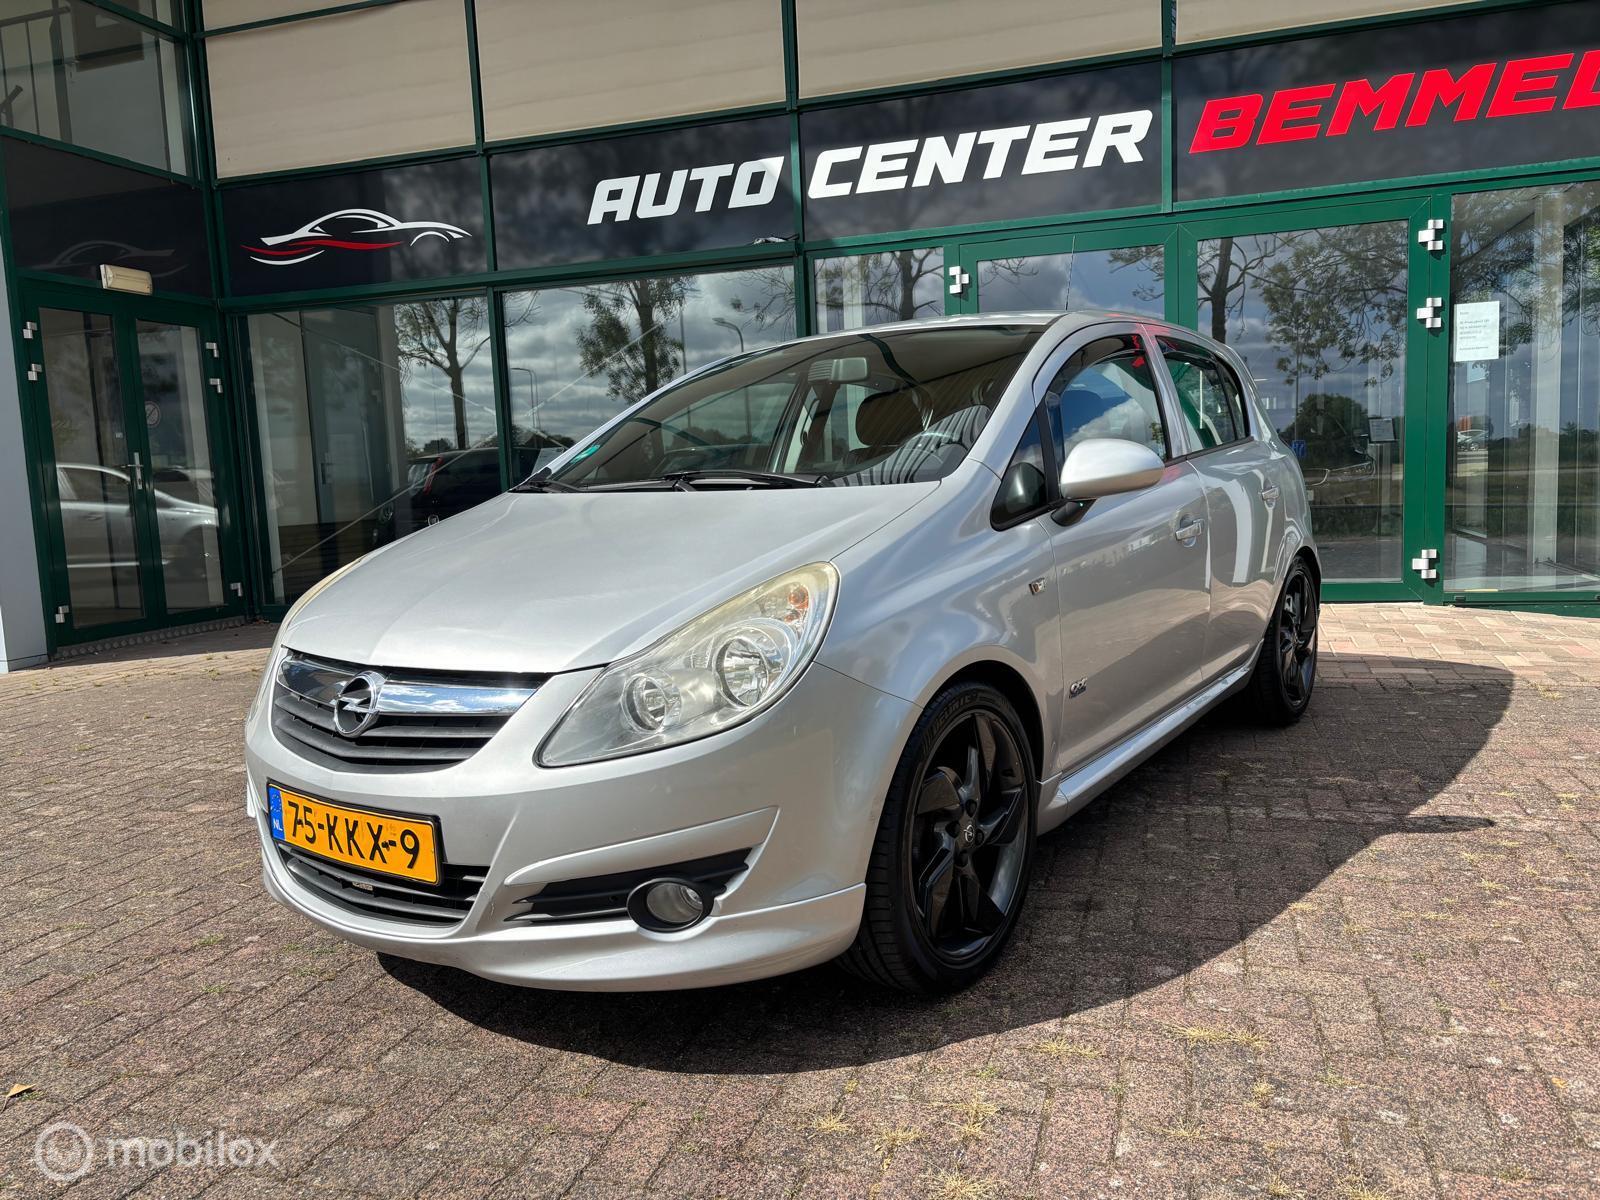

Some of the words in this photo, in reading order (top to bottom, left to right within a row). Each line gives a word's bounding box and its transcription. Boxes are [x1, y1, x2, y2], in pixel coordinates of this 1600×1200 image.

[587, 156, 785, 225] AUTO
[808, 109, 1153, 199] CENTER
[273, 818, 283, 831] NL
[288, 801, 419, 869] 75-KKX-9
